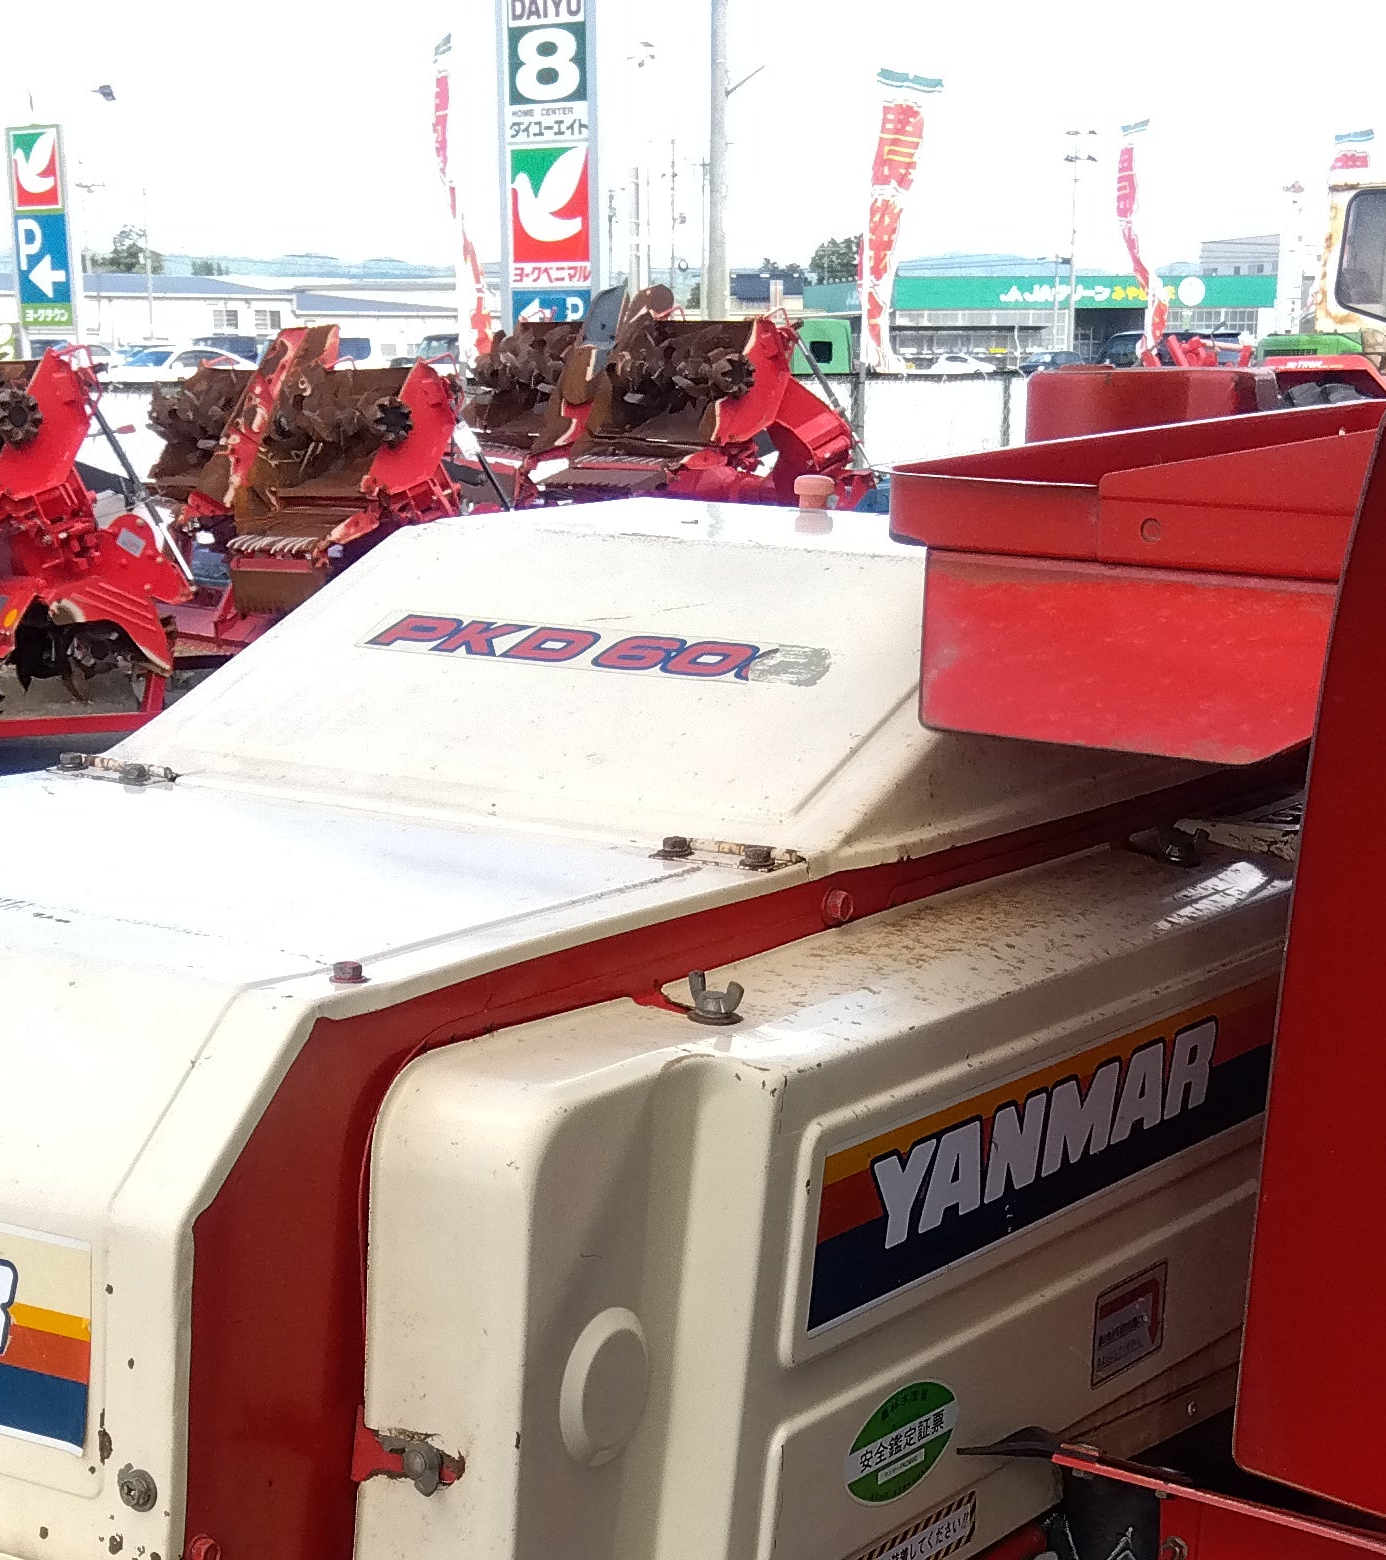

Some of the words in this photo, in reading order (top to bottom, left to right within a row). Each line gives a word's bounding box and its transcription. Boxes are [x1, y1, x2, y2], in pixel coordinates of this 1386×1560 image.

[511, 0, 582, 21] DAIYU
[515, 27, 580, 101] 8
[511, 108, 535, 118] HOME
[540, 106, 574, 117] CENTER
[509, 118, 589, 139] ダイユーエイト
[17, 218, 42, 271] P
[512, 265, 591, 284] ヨークベニマル
[25, 308, 69, 322] ヨークタウン
[565, 297, 584, 322] P
[364, 614, 602, 662] PKD
[869, 1015, 1219, 1250] YANMAR
[859, 1408, 945, 1474] 安全鑑定証票
